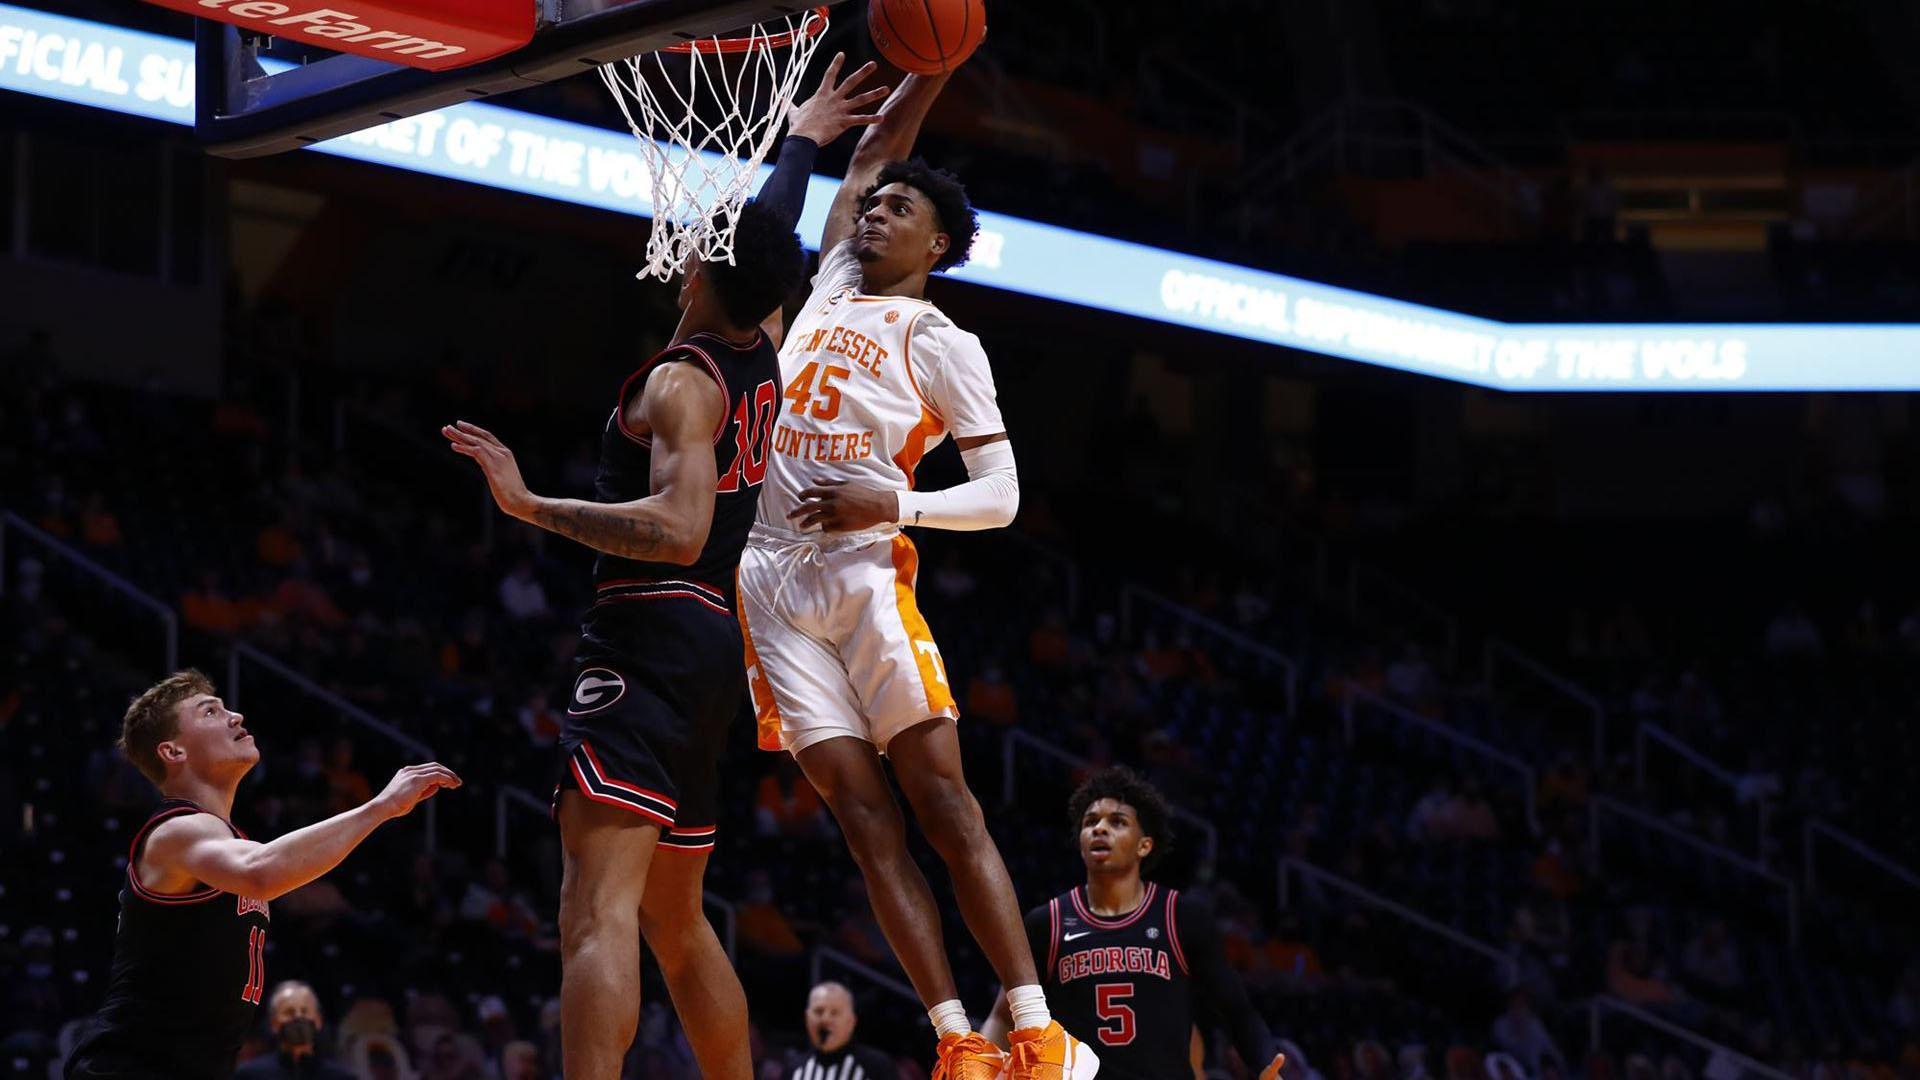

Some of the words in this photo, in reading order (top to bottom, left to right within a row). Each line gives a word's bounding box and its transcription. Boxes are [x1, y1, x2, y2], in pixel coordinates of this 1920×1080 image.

[446, 118, 504, 168] OF
[508, 129, 586, 187] THE
[1161, 269, 1290, 332] OFFICIAL
[1495, 339, 1549, 378] OF
[1554, 339, 1637, 378] THE
[1641, 339, 1747, 379] VOLS
[784, 362, 850, 422] 45
[716, 379, 777, 493] 10
[771, 425, 874, 461] UNTEERS
[242, 925, 266, 1006] 11
[1058, 947, 1171, 984] GEORGIA
[1095, 983, 1136, 1046] 5
